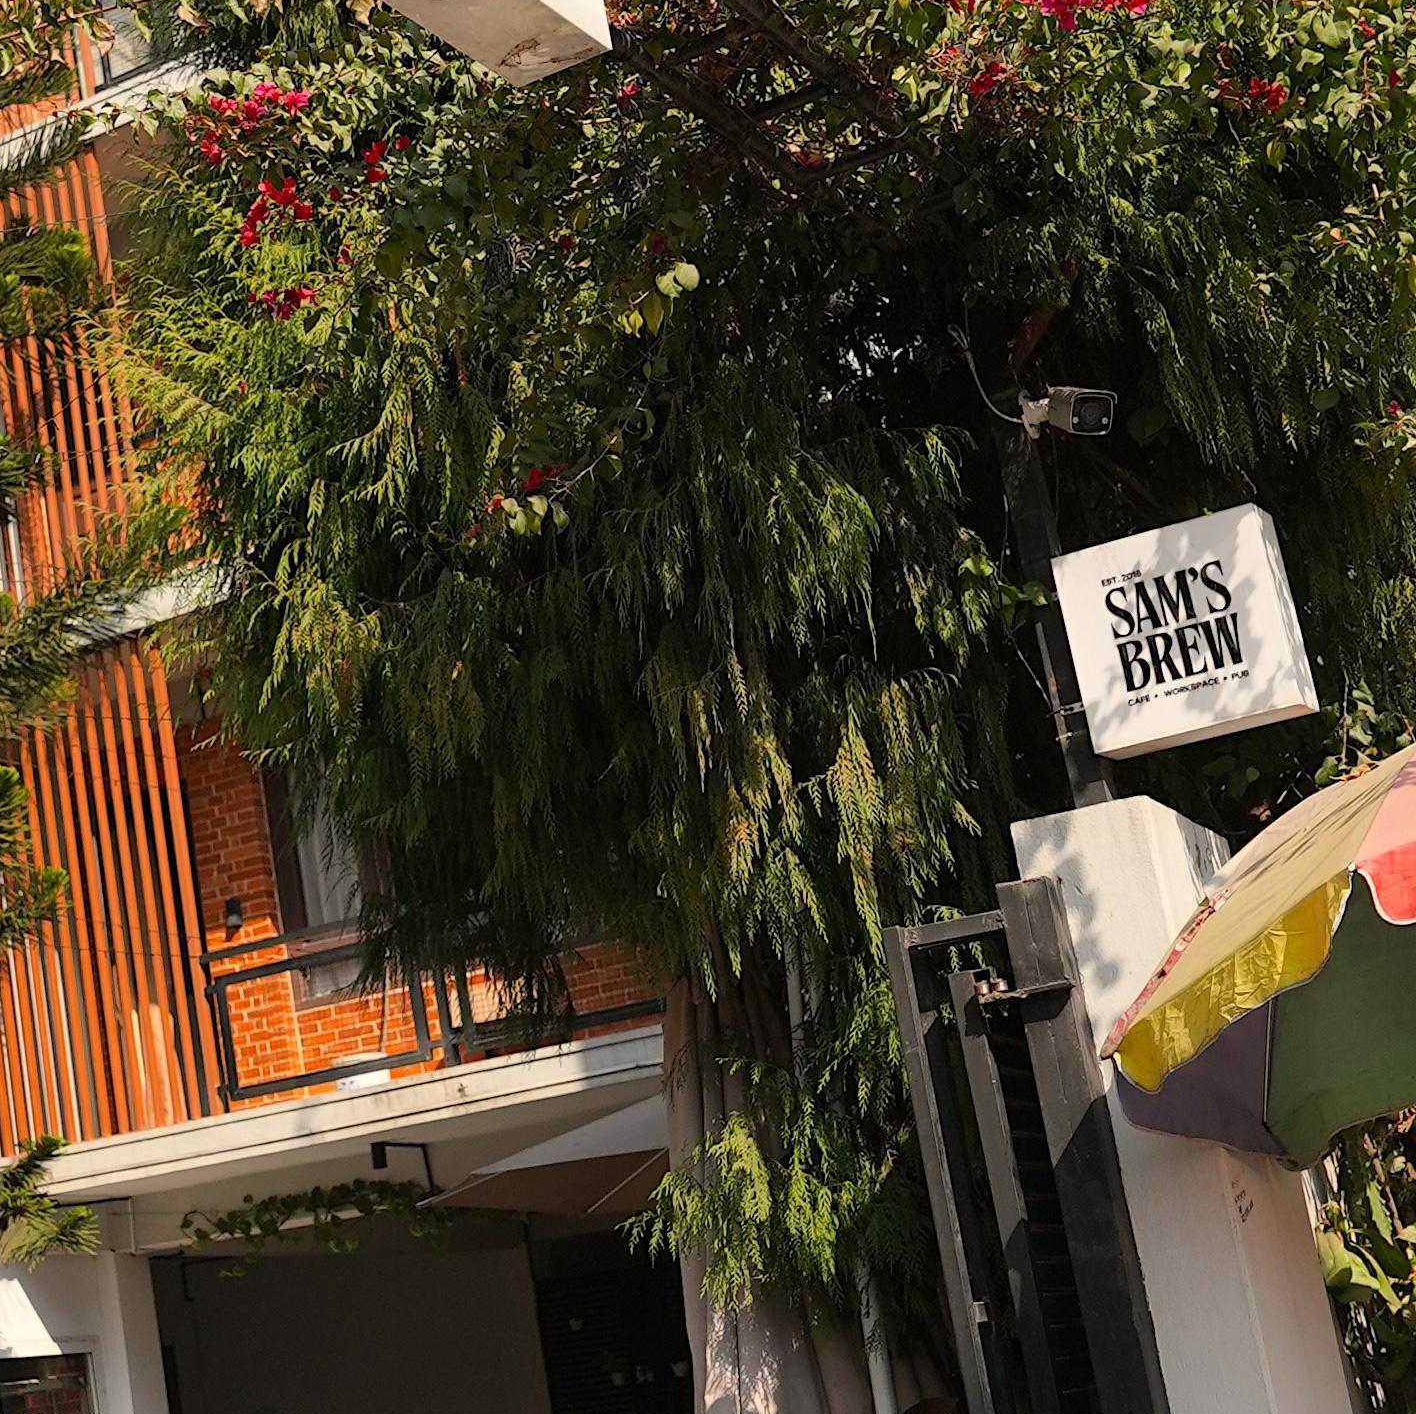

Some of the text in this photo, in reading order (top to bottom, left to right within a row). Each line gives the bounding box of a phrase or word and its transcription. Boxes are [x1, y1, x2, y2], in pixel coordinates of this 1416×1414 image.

[1105, 559, 1232, 640] SAM'S
[1116, 612, 1243, 693] BREW
[1127, 669, 1250, 707] CAFE WORKSPACE PUB
